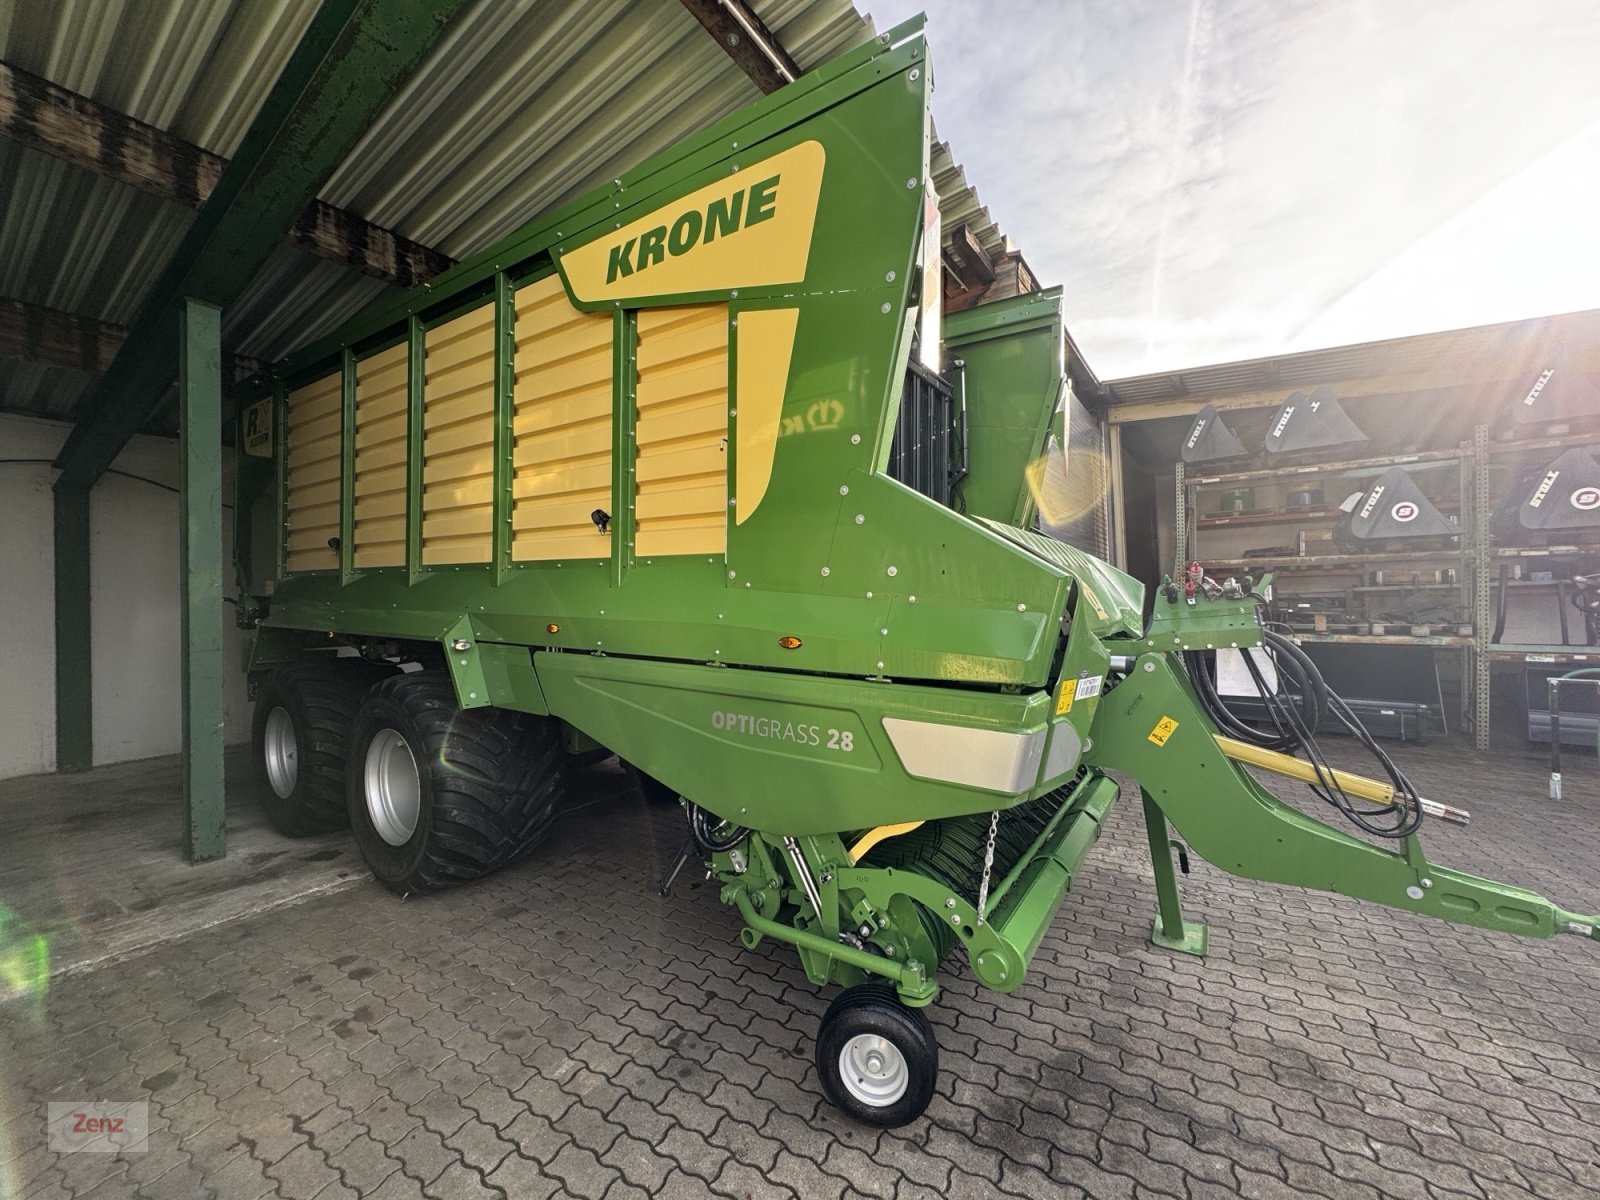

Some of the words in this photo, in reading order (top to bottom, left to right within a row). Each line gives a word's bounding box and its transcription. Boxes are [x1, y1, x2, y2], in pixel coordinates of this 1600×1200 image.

[605, 173, 782, 286] KRONE
[1523, 369, 1555, 406] STOLL
[1187, 419, 1206, 449] STOLL
[1273, 406, 1295, 438] STOLL
[1360, 485, 1385, 519] STOLL
[1529, 470, 1560, 508] STOLL
[711, 710, 820, 746] OPTIGRASS
[826, 728, 854, 752] 28
